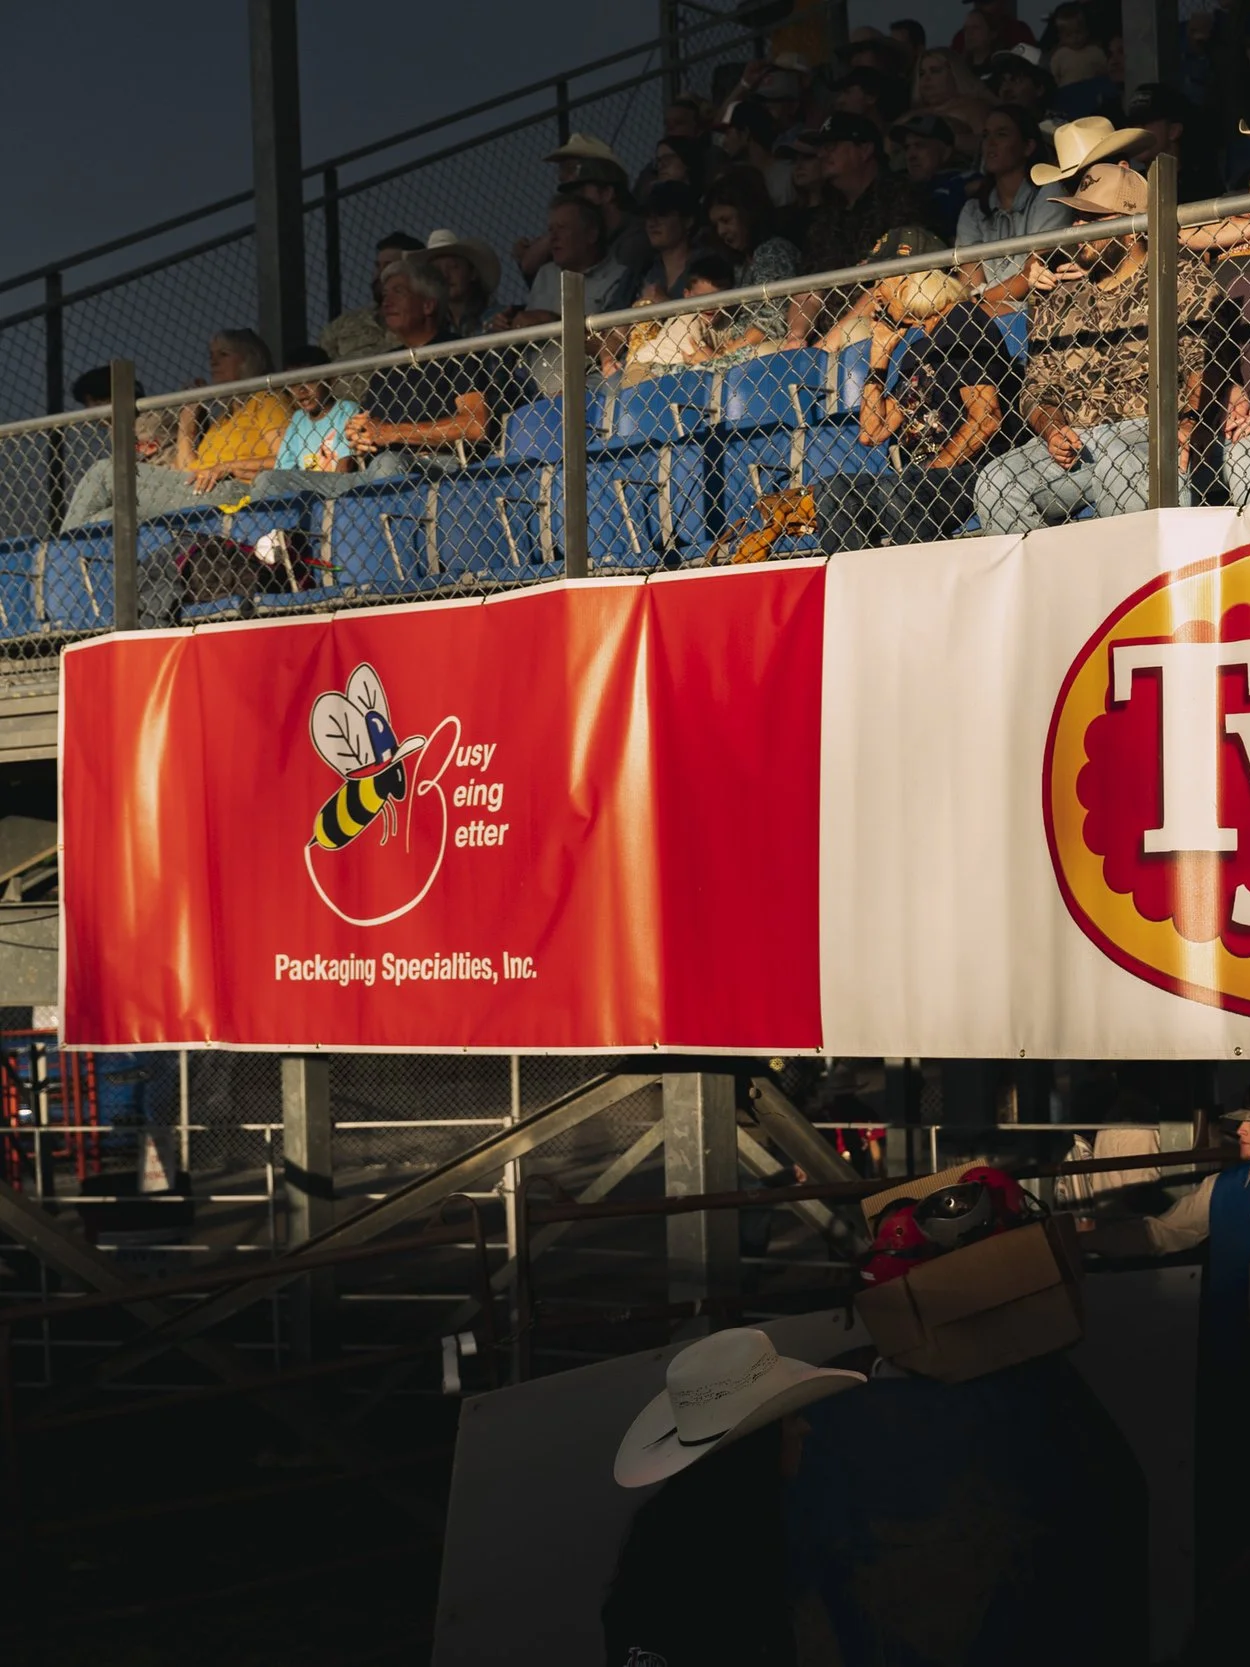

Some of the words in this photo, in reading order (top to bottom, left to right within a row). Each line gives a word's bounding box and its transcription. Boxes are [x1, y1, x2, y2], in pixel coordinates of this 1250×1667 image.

[275, 953, 376, 986] Packaging
[381, 952, 498, 986] Specialties,
[503, 951, 537, 979] Inc.
